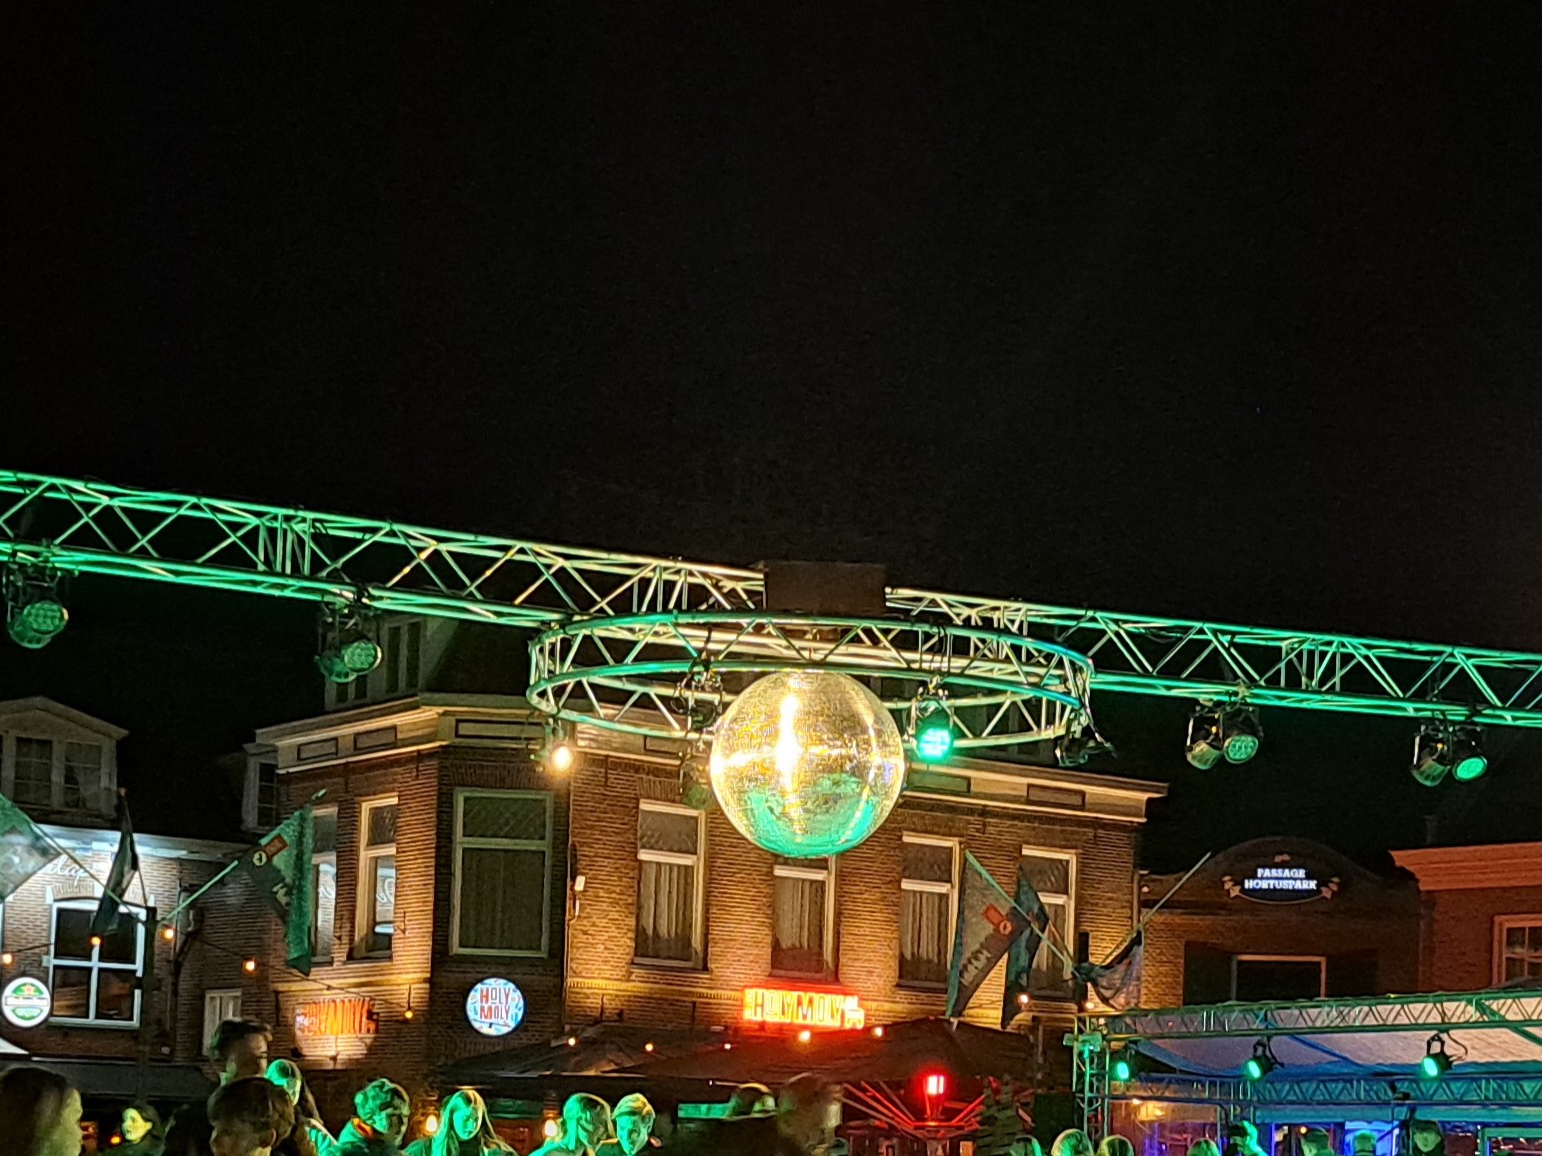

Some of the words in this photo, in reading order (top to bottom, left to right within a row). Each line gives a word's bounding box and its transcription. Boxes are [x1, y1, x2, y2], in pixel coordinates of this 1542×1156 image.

[1257, 868, 1306, 878] PASSAGE
[1244, 879, 1318, 891] HORTUSPARK
[480, 987, 510, 1004] HOLY
[480, 1005, 510, 1020] MOLY
[752, 988, 793, 1022] HOLY
[793, 992, 843, 1026] MOLY
